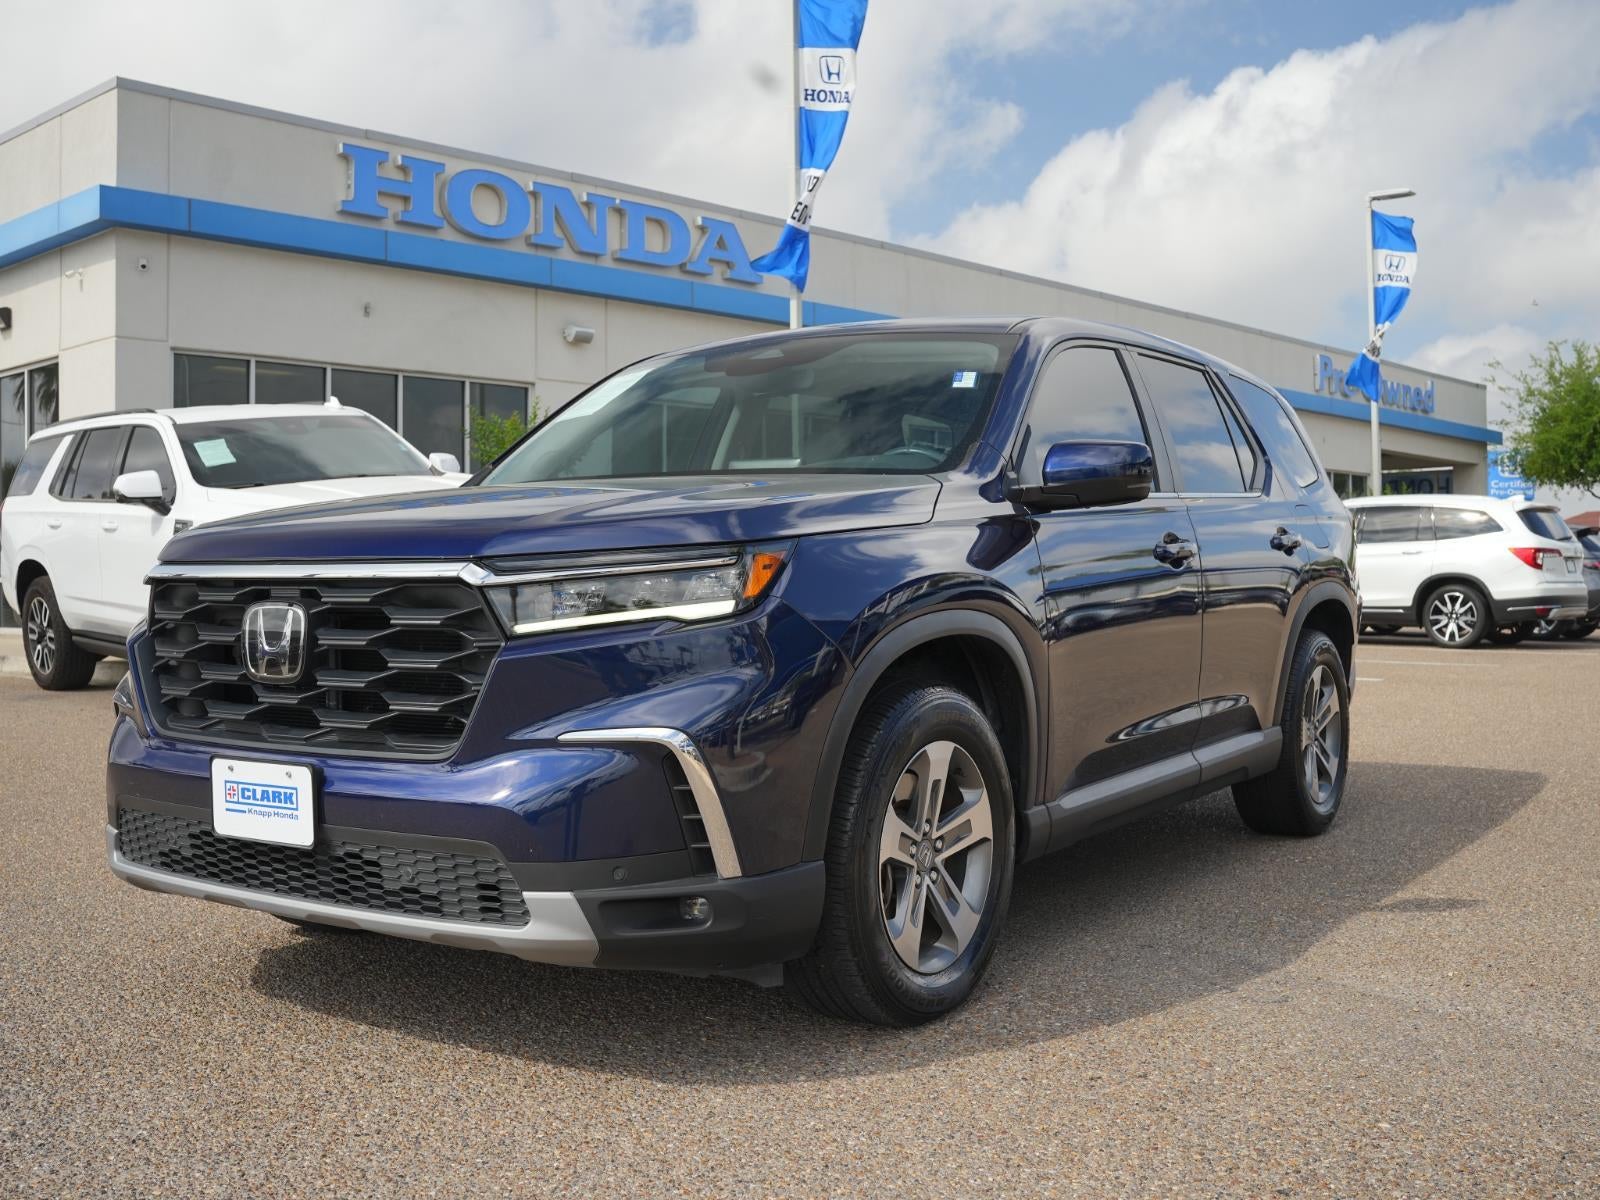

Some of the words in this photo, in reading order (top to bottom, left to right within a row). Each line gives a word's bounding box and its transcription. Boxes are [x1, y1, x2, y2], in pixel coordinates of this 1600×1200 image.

[337, 142, 763, 284] HONDA
[240, 786, 295, 806] CLARK
[247, 807, 272, 818] Knapp
[273, 810, 299, 821] Honda
